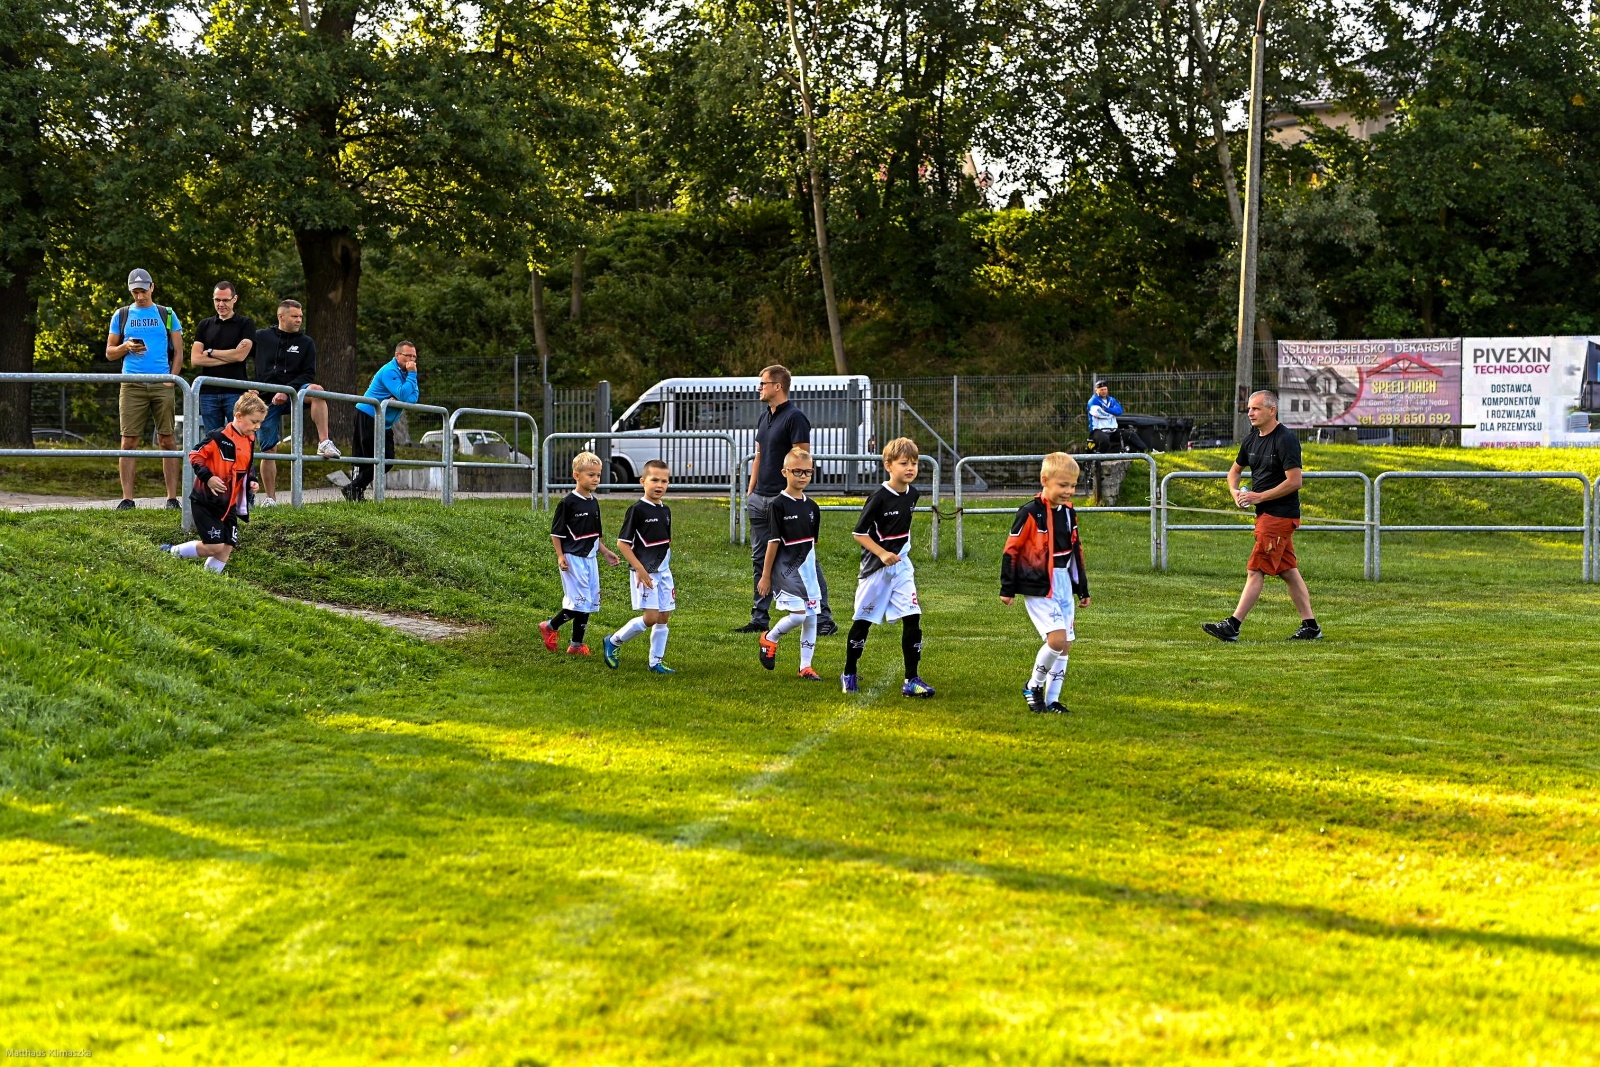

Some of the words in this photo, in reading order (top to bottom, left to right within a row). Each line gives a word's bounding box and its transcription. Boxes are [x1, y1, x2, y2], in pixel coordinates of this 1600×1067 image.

[131, 319, 141, 327] BIG
[142, 319, 159, 327] STAR
[1282, 344, 1320, 354] USŁUGI
[1323, 344, 1386, 355] CIESIELSKO
[1394, 342, 1458, 353] DEKARSKIE
[1282, 355, 1314, 365] DOMY
[1317, 355, 1340, 365] POD
[1343, 354, 1378, 365] KLUCZ
[1473, 347, 1551, 363] PIVEXIN
[1473, 364, 1551, 375] TECHNOLOGY
[1491, 384, 1532, 393] DOSTAWCA
[1482, 396, 1541, 406] KOMPONENTÓW
[1357, 414, 1376, 425] tel.
[1379, 413, 1401, 425] 698
[1404, 413, 1426, 424] 650
[1429, 413, 1451, 424] 692
[1491, 408, 1536, 420] ROZWIĄZAŃ
[1480, 422, 1495, 431] DLA
[1497, 421, 1543, 431] PRZEMYSŁU
